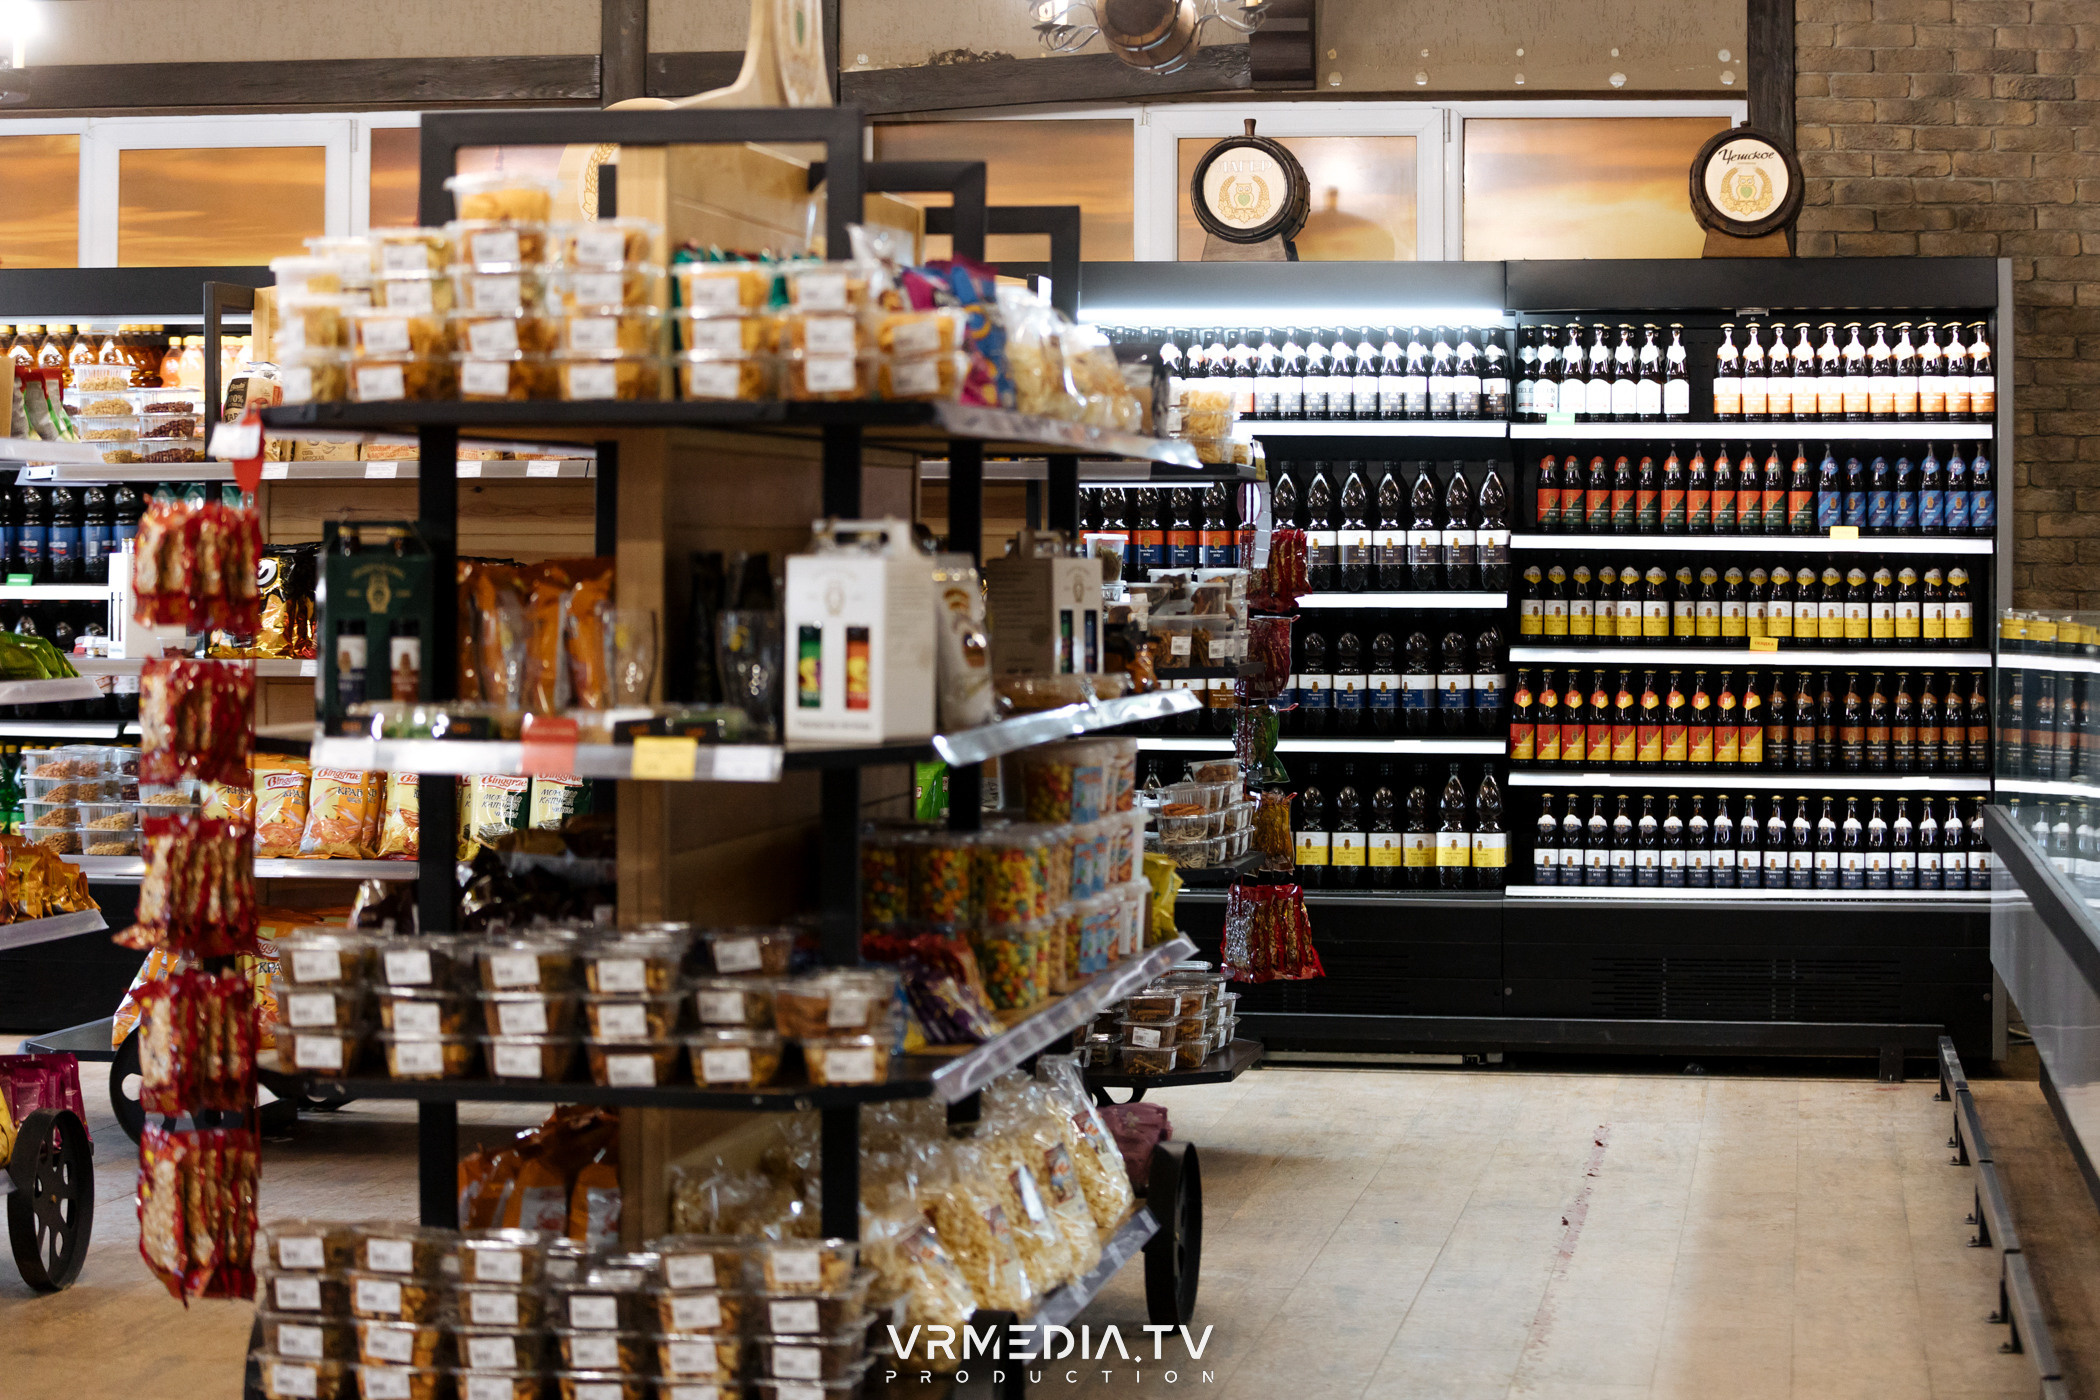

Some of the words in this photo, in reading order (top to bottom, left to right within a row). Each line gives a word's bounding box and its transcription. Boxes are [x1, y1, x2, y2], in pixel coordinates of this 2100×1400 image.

[1718, 149, 1775, 165] Чешское
[317, 768, 362, 780] Binggrae
[481, 774, 528, 788] Binggrae
[337, 786, 364, 797] КРАБ
